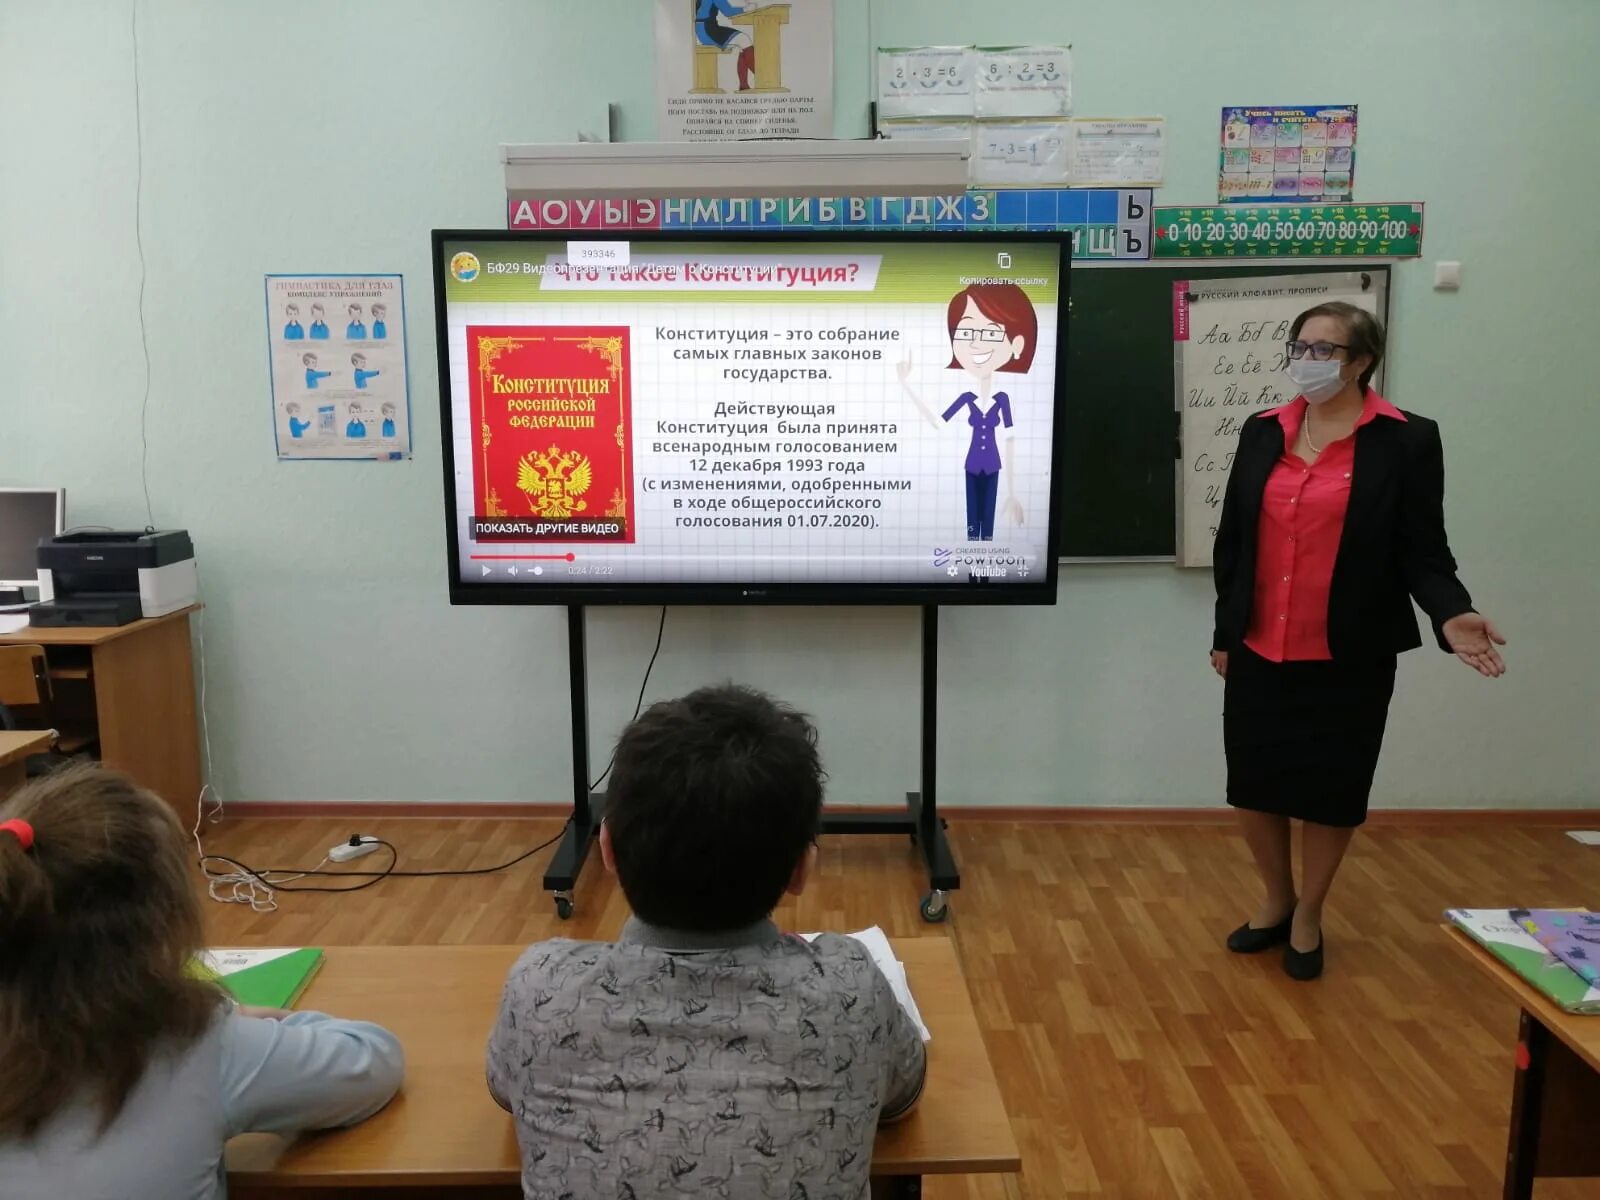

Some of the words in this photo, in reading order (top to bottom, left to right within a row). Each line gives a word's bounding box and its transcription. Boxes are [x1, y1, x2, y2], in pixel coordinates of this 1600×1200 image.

[1169, 223, 1179, 241] 0
[1184, 223, 1202, 241] 10
[1207, 223, 1225, 241] 20
[1229, 223, 1248, 240] 30
[1252, 222, 1271, 240] 40
[1275, 222, 1294, 240] 50
[1296, 221, 1315, 240] 60
[1318, 221, 1336, 240] 70
[1338, 221, 1356, 240] 80
[1360, 221, 1378, 239] 90
[1381, 221, 1407, 239] 100
[581, 249, 616, 258] 393346
[487, 262, 520, 274] БФ29
[684, 263, 859, 288] Конституция?
[276, 282, 341, 290] ГИМНАСТИКА
[345, 282, 366, 290] ДЛЯ
[960, 276, 1014, 287] Копировать
[1016, 277, 1048, 286] ссылку
[1201, 291, 1239, 299] РУССКИЙ
[1288, 286, 1328, 295] ПРОПИСИ
[655, 327, 769, 344] Конституция
[786, 329, 813, 341] это
[818, 327, 900, 344] собрание
[1197, 324, 1232, 345] Аа
[1239, 321, 1274, 342] Бб
[673, 349, 728, 360] самых
[734, 349, 806, 360] главных
[811, 349, 882, 360] законов
[1214, 355, 1234, 375] Ее
[1241, 352, 1261, 374] Ёё
[723, 367, 833, 383] государства.
[1189, 388, 1216, 408] Ии
[1222, 383, 1250, 406] Йй
[1256, 385, 1282, 404] Кк
[714, 401, 835, 418] Действующая
[657, 420, 768, 437] Конституция
[778, 420, 821, 435] была
[826, 422, 897, 437] принята
[652, 441, 771, 456] всенародным
[776, 440, 897, 453] голосованием
[689, 460, 707, 472] 12
[712, 458, 781, 474] декабря
[787, 459, 823, 472] 1993
[828, 461, 865, 474] года
[1194, 453, 1215, 472] Сс
[642, 478, 656, 493] (с
[661, 479, 786, 493] изменениями,
[791, 477, 911, 494] одобренными
[673, 499, 683, 509] в
[687, 499, 727, 512] ходе
[731, 496, 882, 512] общероссийского
[476, 523, 534, 533] ПОКАЗАТЬ
[536, 523, 579, 535] ДРУГИЕ
[581, 523, 619, 534] ВИДЕО
[675, 516, 783, 528] голосования
[787, 514, 880, 530] 01.07.2020).
[568, 566, 587, 575] 0:24
[970, 565, 1007, 577] YouTube
